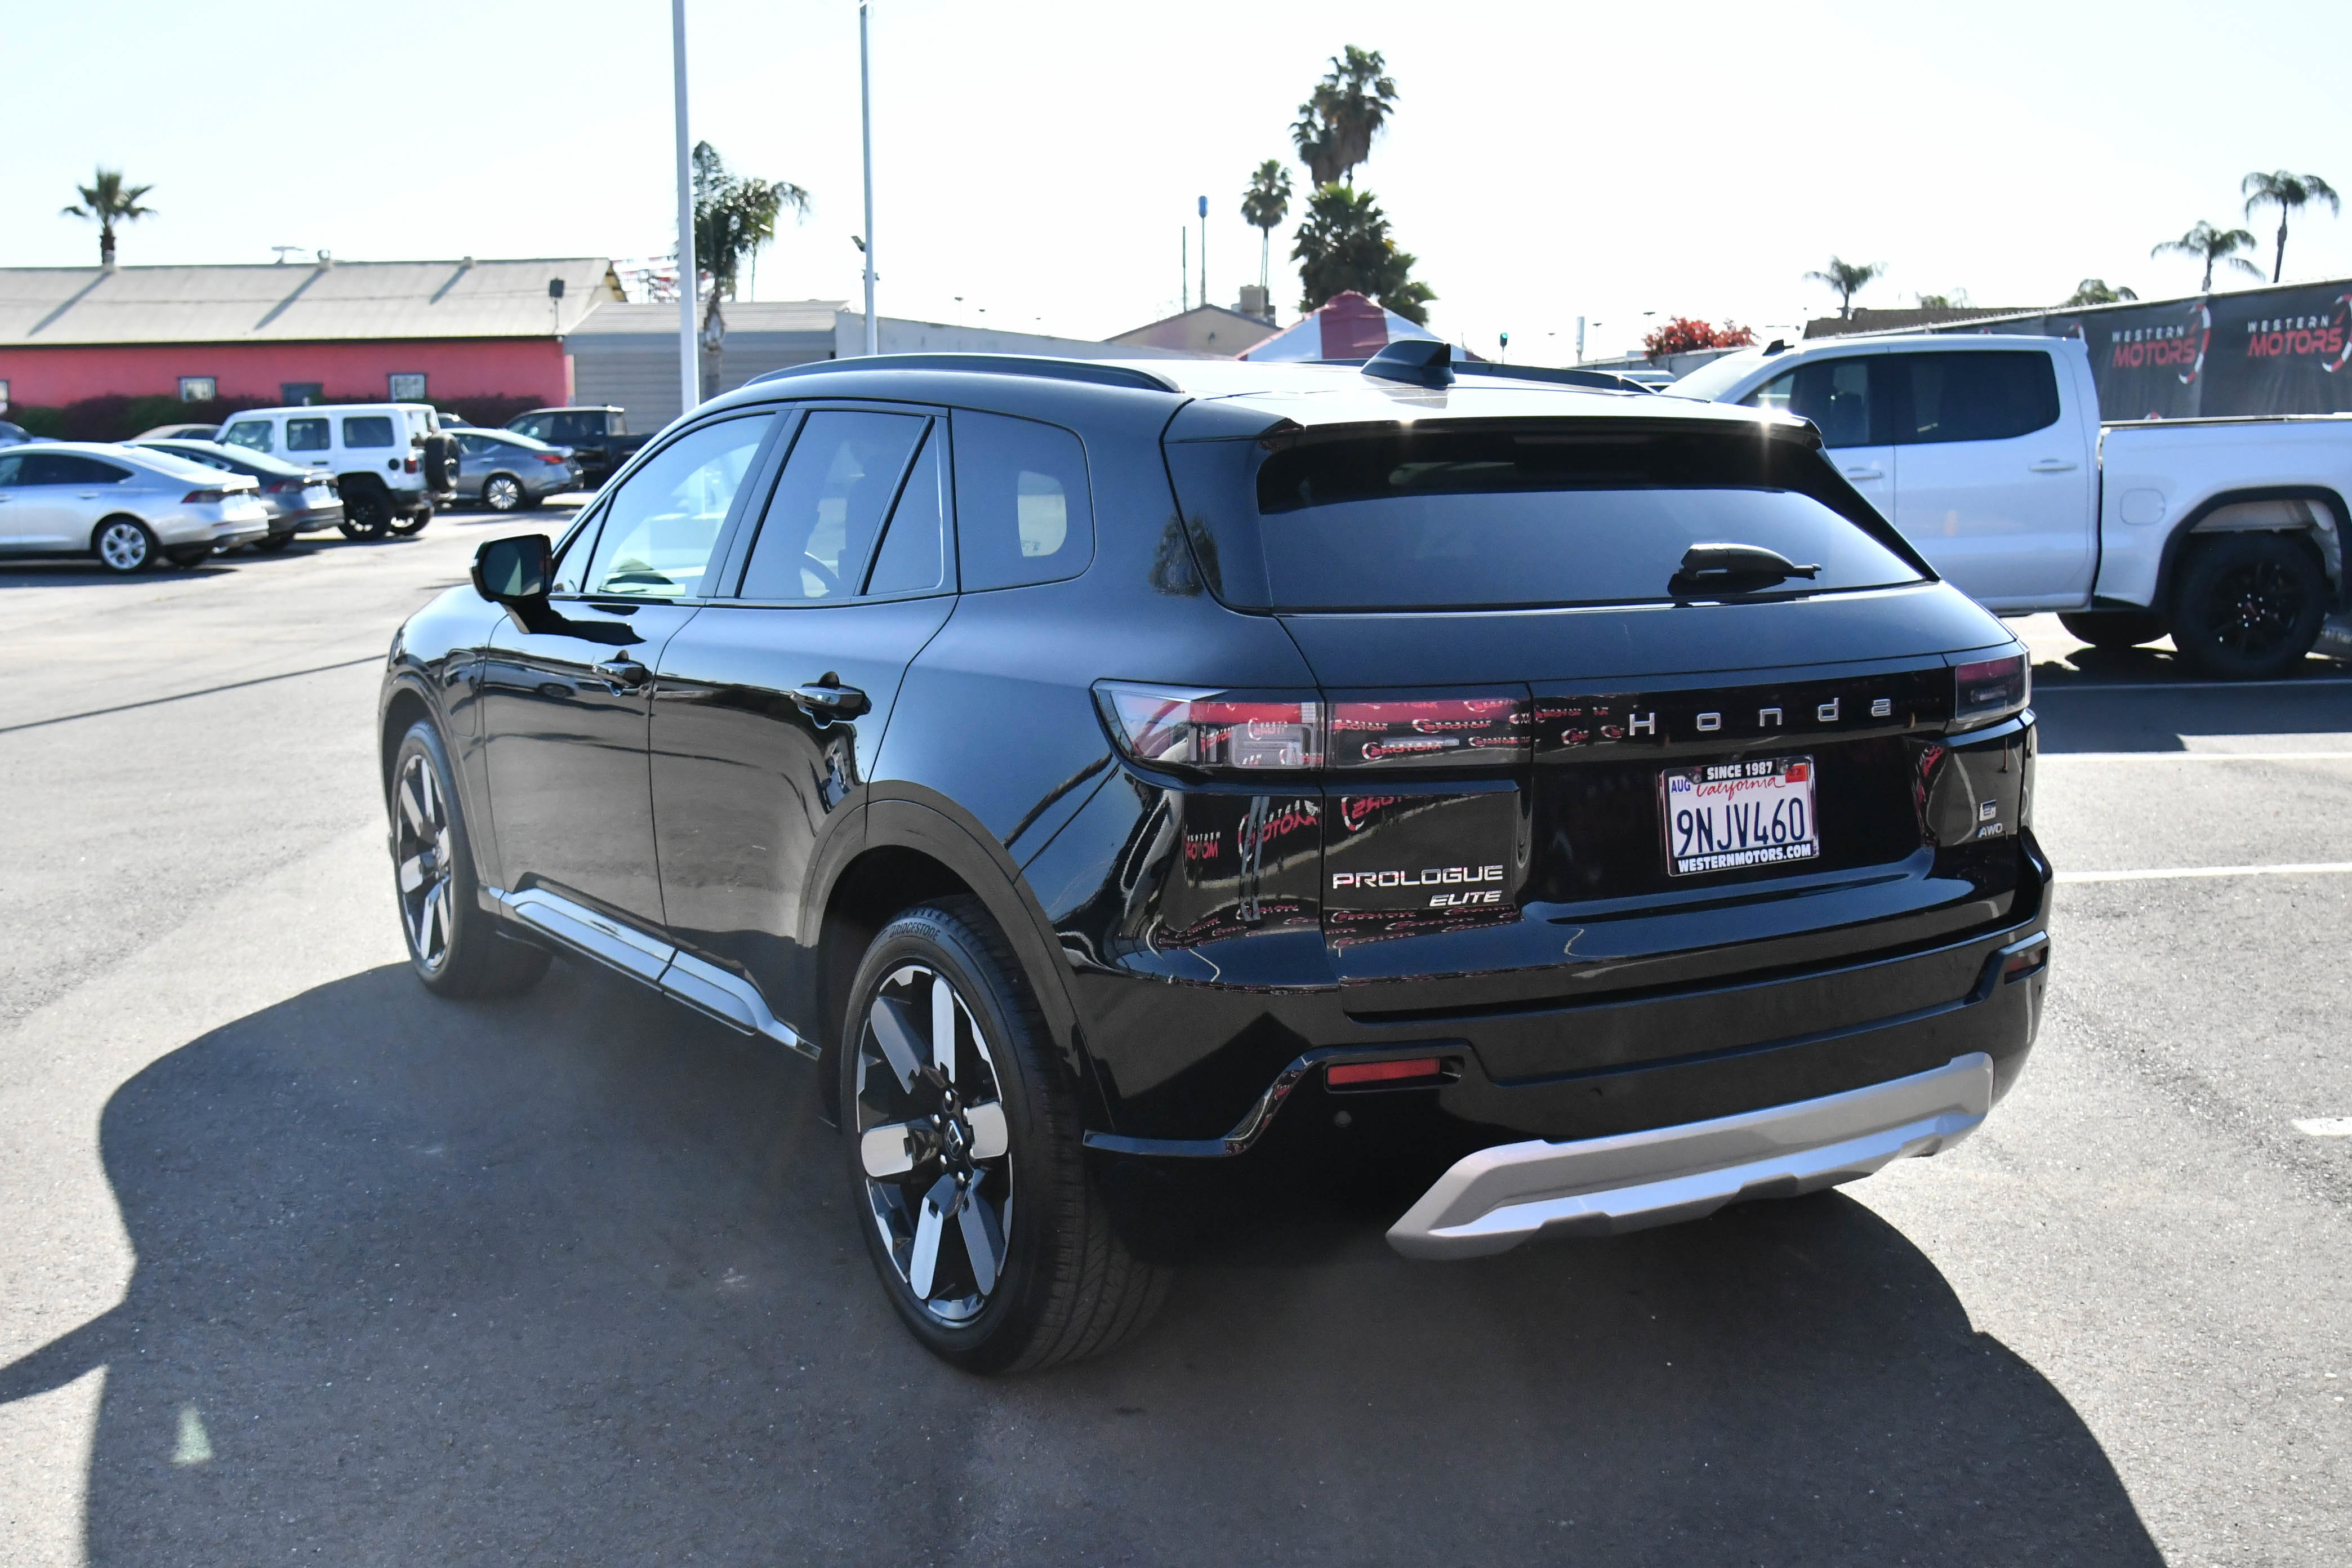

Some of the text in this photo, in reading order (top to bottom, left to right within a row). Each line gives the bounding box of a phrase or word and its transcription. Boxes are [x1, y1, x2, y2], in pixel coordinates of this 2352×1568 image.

[2112, 325, 2185, 343] WESTERN
[2247, 315, 2329, 334] WESTERN
[2112, 337, 2197, 368] MOTORS
[2247, 327, 2344, 357] MOTORS
[1629, 697, 1891, 736] Honda
[1707, 764, 1741, 781] SINCE
[1745, 761, 1773, 776] 1987
[1671, 779, 1691, 794] AUG
[1676, 797, 1805, 856] 9NJV460
[1977, 822, 2003, 838] AWD
[1678, 843, 1811, 873] WESTERNMOTORS.COM
[1332, 865, 1504, 889] PROLOGUE
[1429, 890, 1502, 907] ELITE
